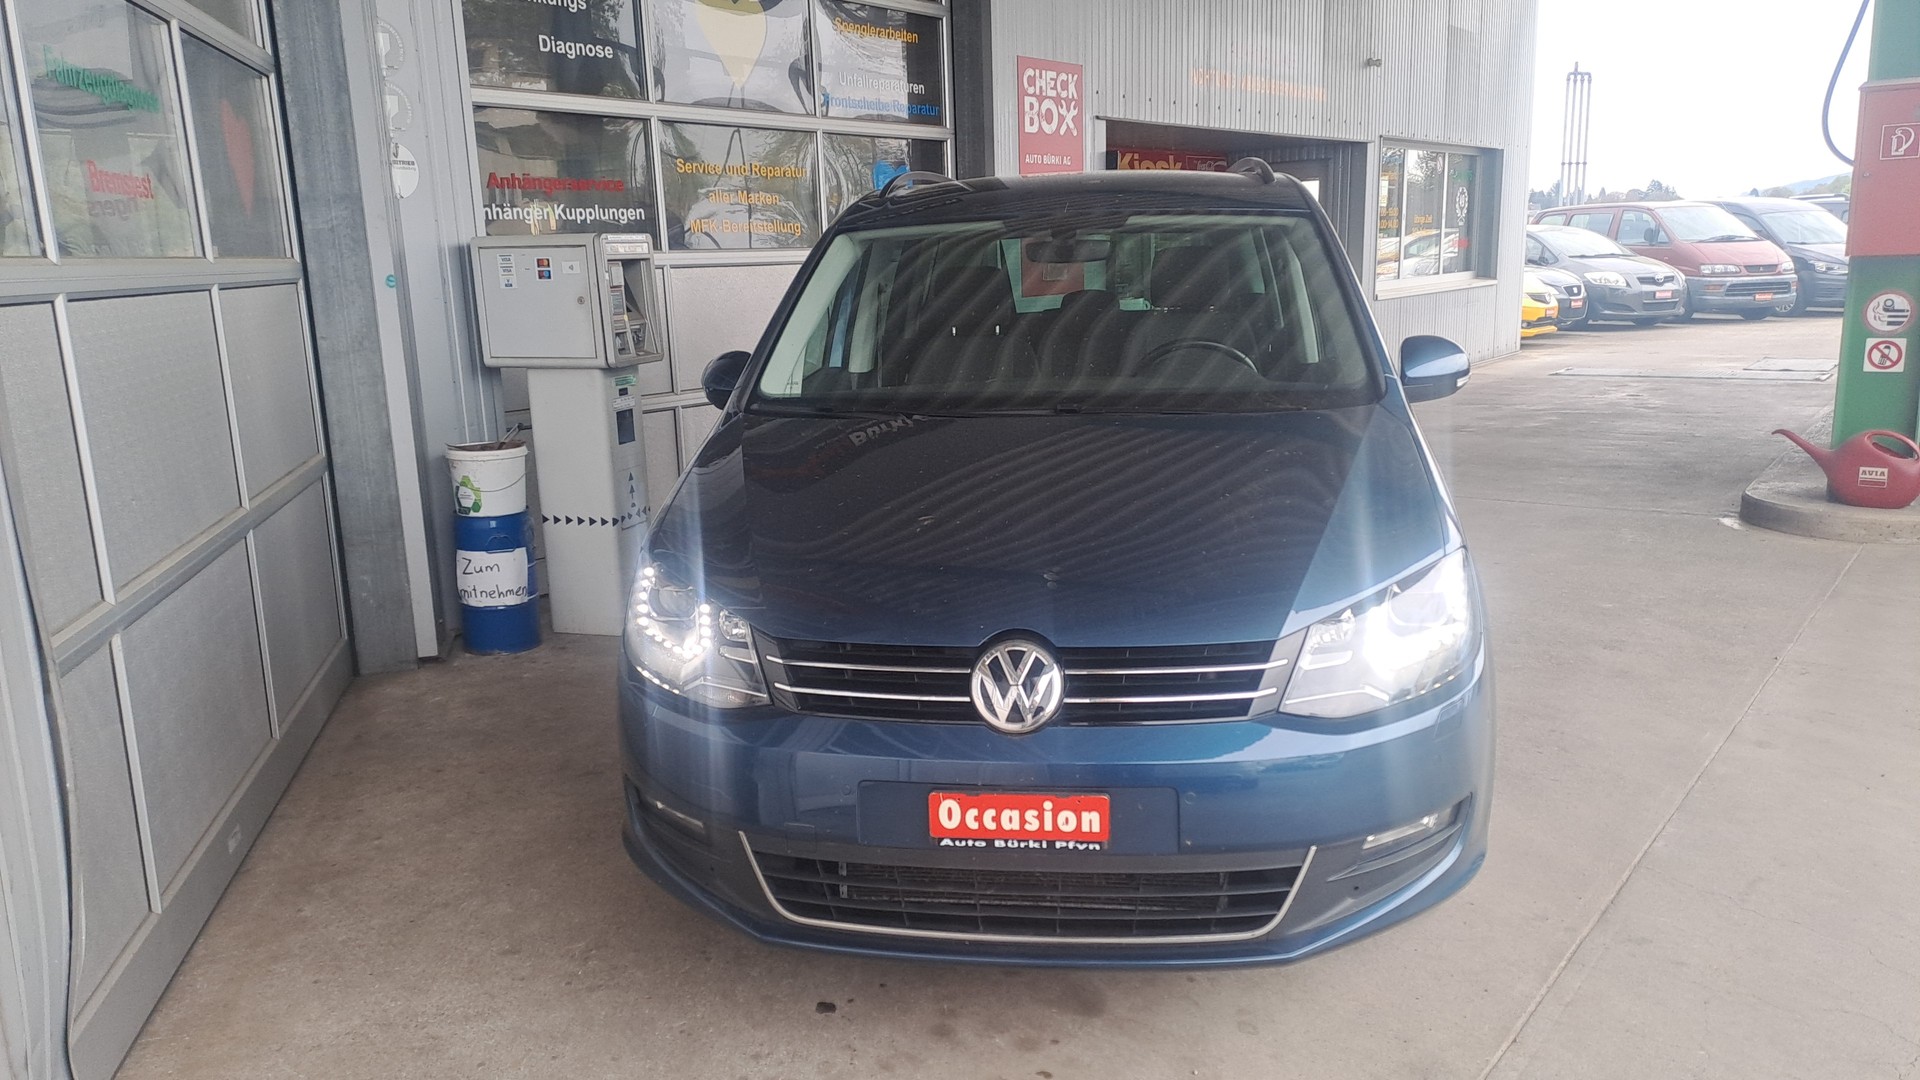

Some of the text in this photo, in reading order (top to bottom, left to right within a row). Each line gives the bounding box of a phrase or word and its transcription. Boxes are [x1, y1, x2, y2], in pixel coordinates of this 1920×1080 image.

[834, 17, 919, 44] Spenglerarbeiten
[538, 34, 614, 59] Diagnose
[839, 71, 925, 95] Unfallreparaturen
[1023, 67, 1078, 99] CHECK
[892, 99, 939, 117] Reparatur
[1024, 96, 1079, 137] BOX
[676, 158, 810, 180] Service und Reparatur
[1025, 153, 1072, 165] AUTO BÜRKI AG
[1119, 152, 1182, 170] Kiosk
[486, 172, 625, 195] Anhängerservice
[708, 189, 781, 205] aller Marken
[554, 203, 646, 225] Kupplungen
[690, 218, 803, 236] MFK-Bereitstellung
[462, 557, 501, 575] Zum
[459, 583, 527, 600] mitnehmen
[938, 798, 1101, 833] Occasion
[939, 838, 1101, 851] Auto Bürki Pfyn
